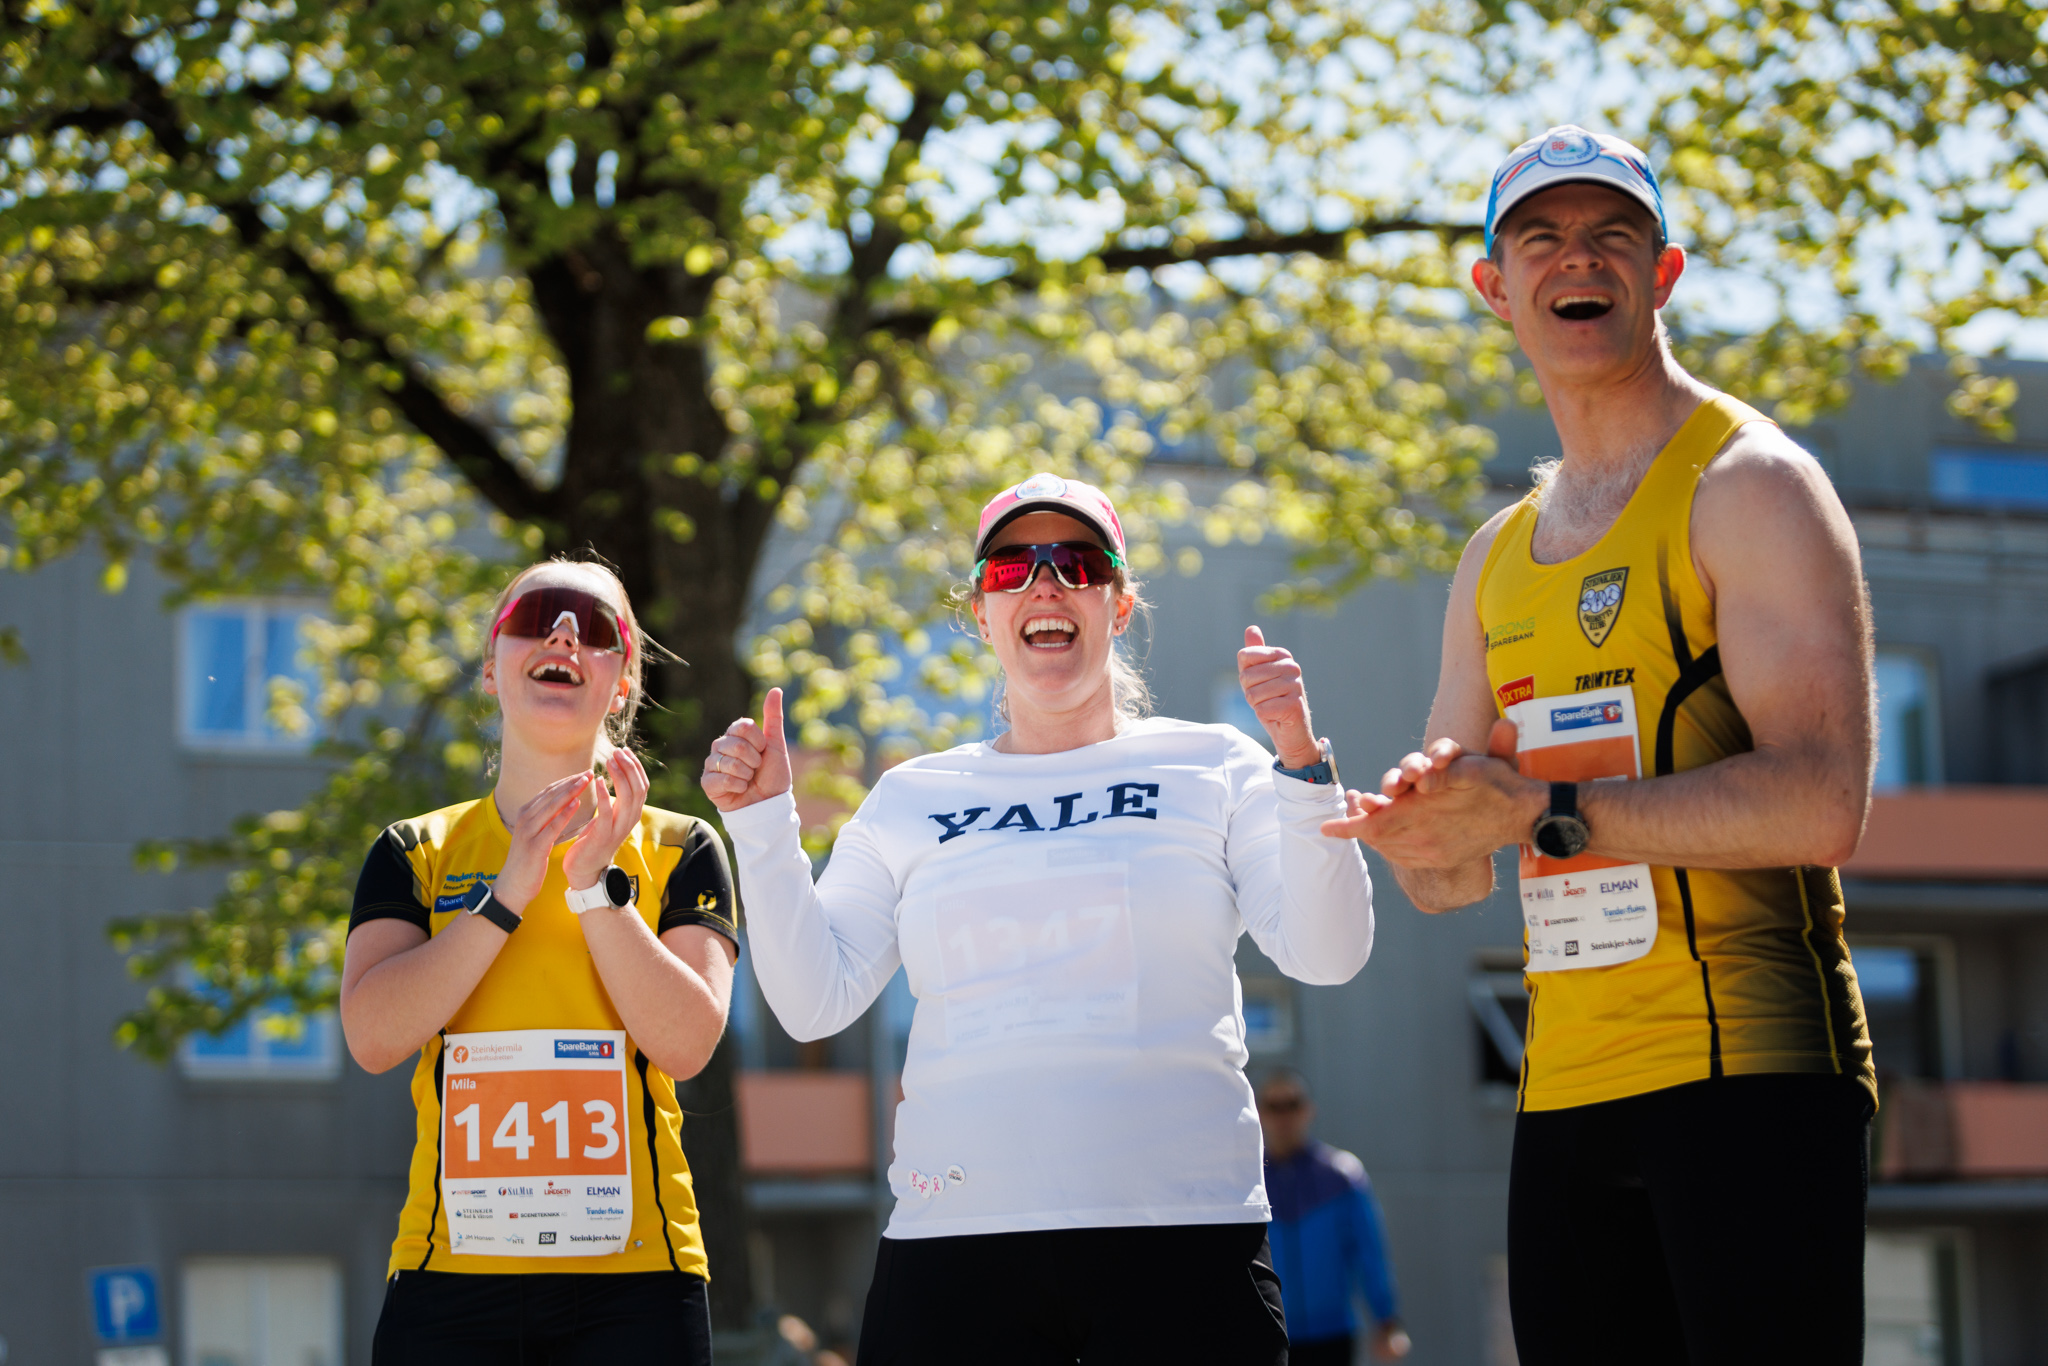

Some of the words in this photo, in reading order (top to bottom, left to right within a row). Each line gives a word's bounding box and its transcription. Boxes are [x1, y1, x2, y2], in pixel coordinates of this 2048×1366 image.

[1490, 616, 1536, 641] GRONG
[1490, 630, 1535, 650] SPAREBANK
[1575, 667, 1636, 692] TRIMTEX
[1554, 706, 1602, 723] SpareBank
[927, 782, 1160, 844] YALE
[1600, 879, 1639, 894] ELMAN
[471, 1043, 523, 1055] Steinkjermila
[557, 1041, 599, 1052] SpareBank
[602, 1044, 609, 1055] 1
[451, 1078, 477, 1090] Mila
[453, 1099, 620, 1162] 1413
[586, 1186, 620, 1196] ELMAN
[540, 1233, 555, 1243] SSA
[108, 1277, 145, 1338] P
